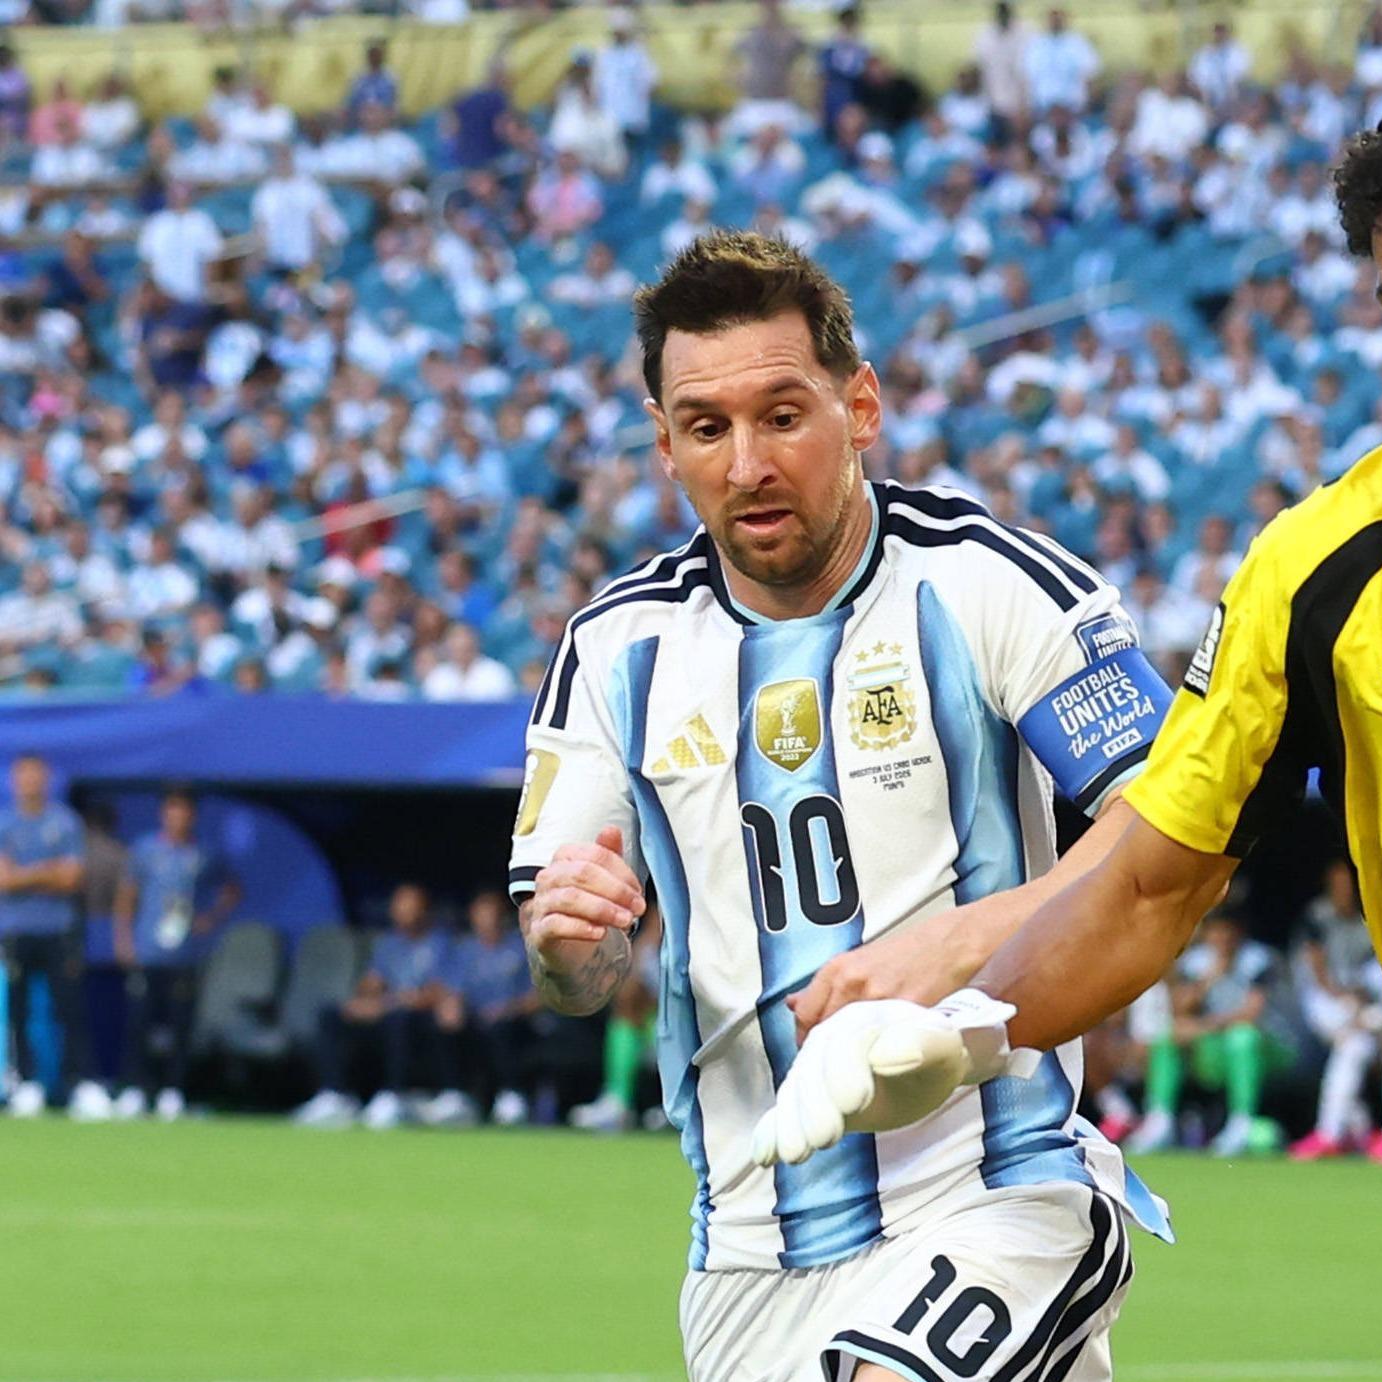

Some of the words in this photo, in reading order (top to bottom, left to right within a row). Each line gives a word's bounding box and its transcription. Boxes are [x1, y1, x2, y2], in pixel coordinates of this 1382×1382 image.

[862, 685, 903, 725] AFA
[1051, 662, 1126, 715] FOOTBALL
[1059, 678, 1139, 736] UNITES
[773, 736, 805, 750] FIFA
[1068, 731, 1101, 760] the
[1099, 695, 1156, 737] World
[1107, 732, 1138, 753] FIFA
[739, 793, 861, 933] 10
[892, 1254, 1012, 1378] 10
